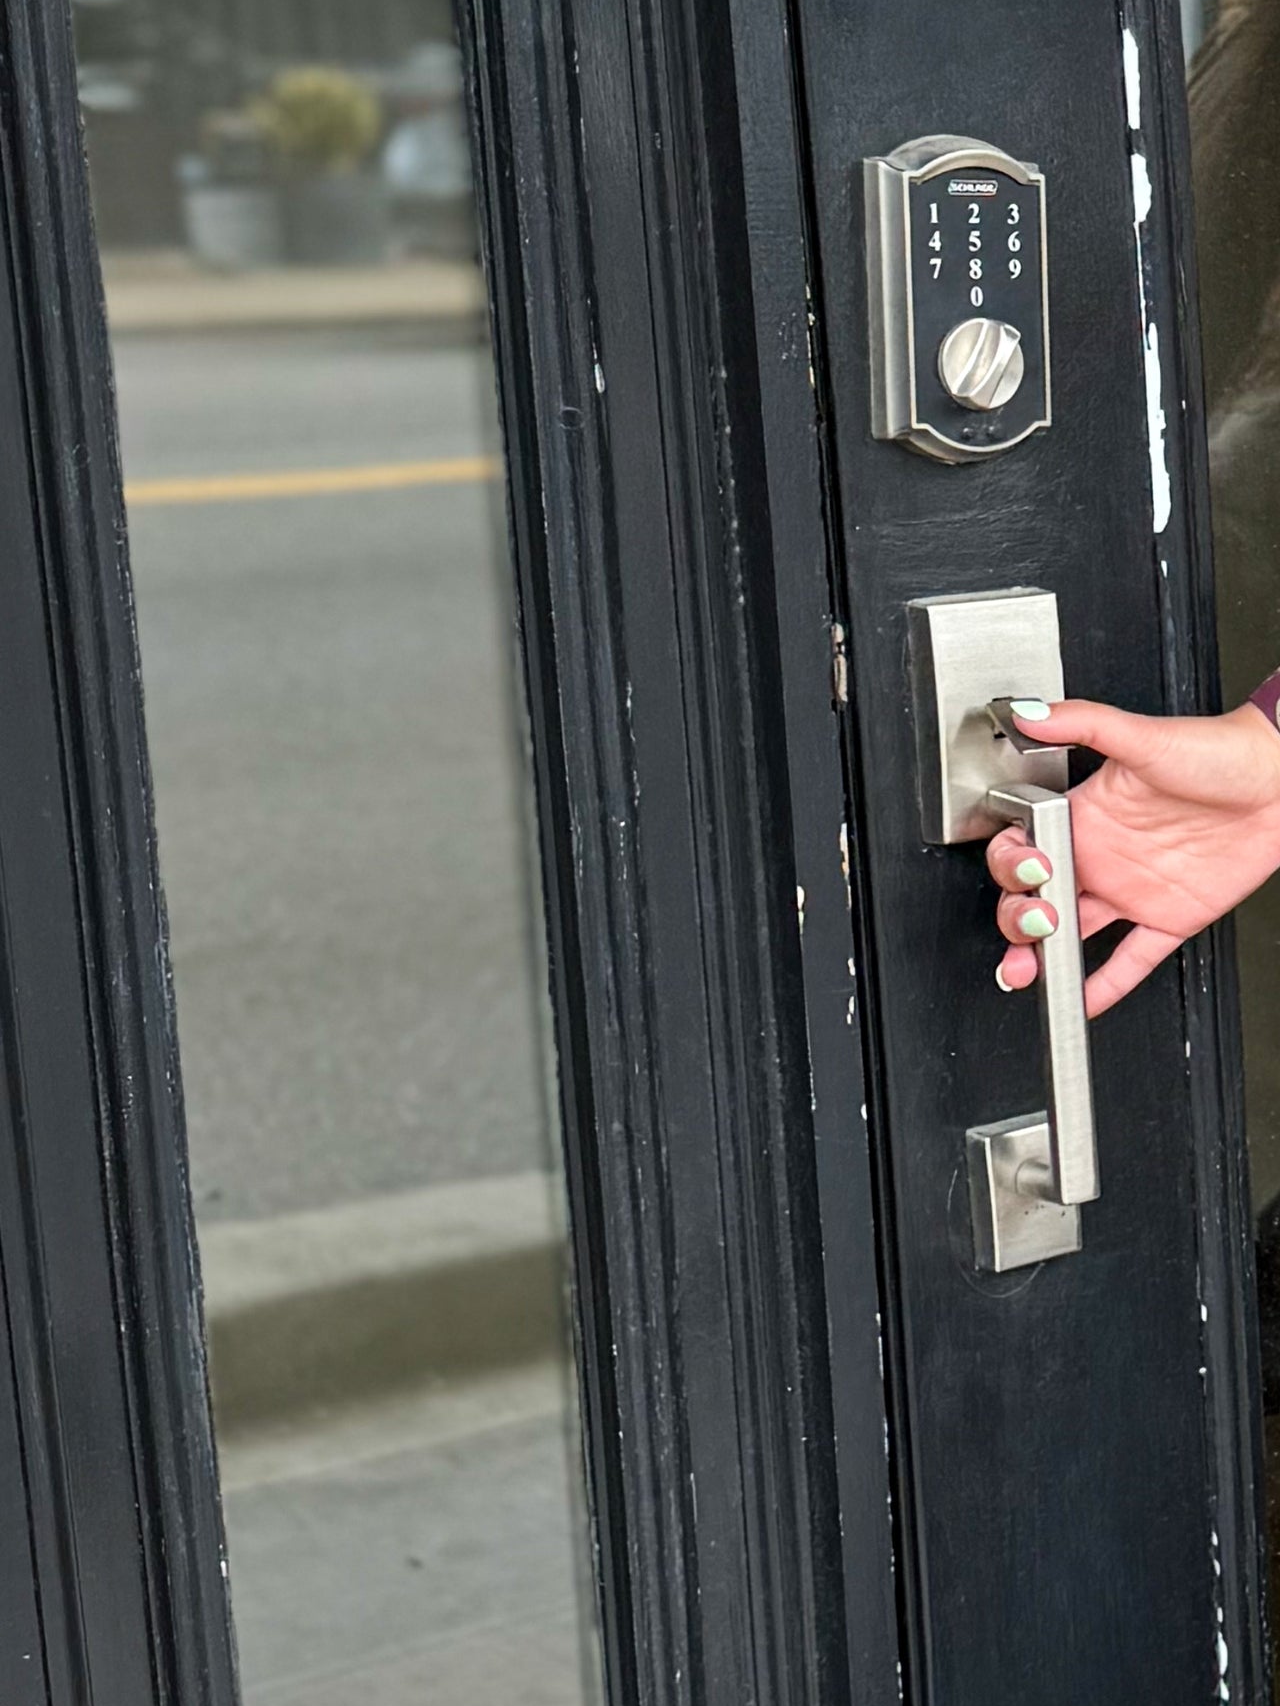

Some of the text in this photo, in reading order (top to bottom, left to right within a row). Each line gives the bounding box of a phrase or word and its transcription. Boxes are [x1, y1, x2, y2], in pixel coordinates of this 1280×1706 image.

[929, 202, 1020, 225] 1 2 3
[928, 230, 1021, 252] 4 5 6
[929, 258, 1022, 280] 7 8 9
[970, 285, 984, 307] 0
